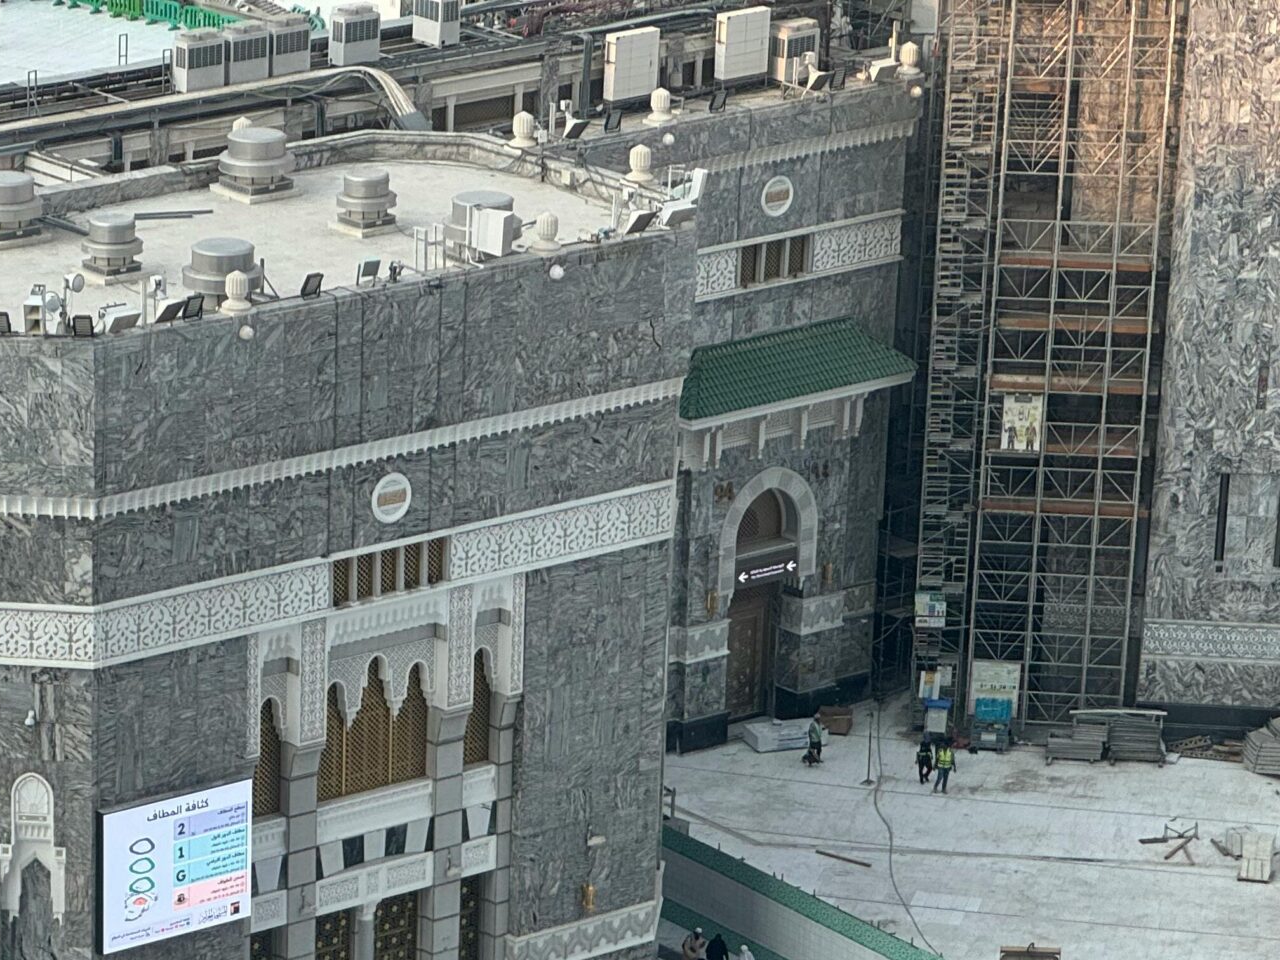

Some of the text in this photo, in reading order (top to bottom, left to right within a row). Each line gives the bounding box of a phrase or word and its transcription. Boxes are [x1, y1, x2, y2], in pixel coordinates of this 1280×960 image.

[147, 798, 209, 821] كثافة المطاف
[177, 823, 186, 836] 2
[177, 846, 185, 859] 1
[176, 869, 187, 882] G
